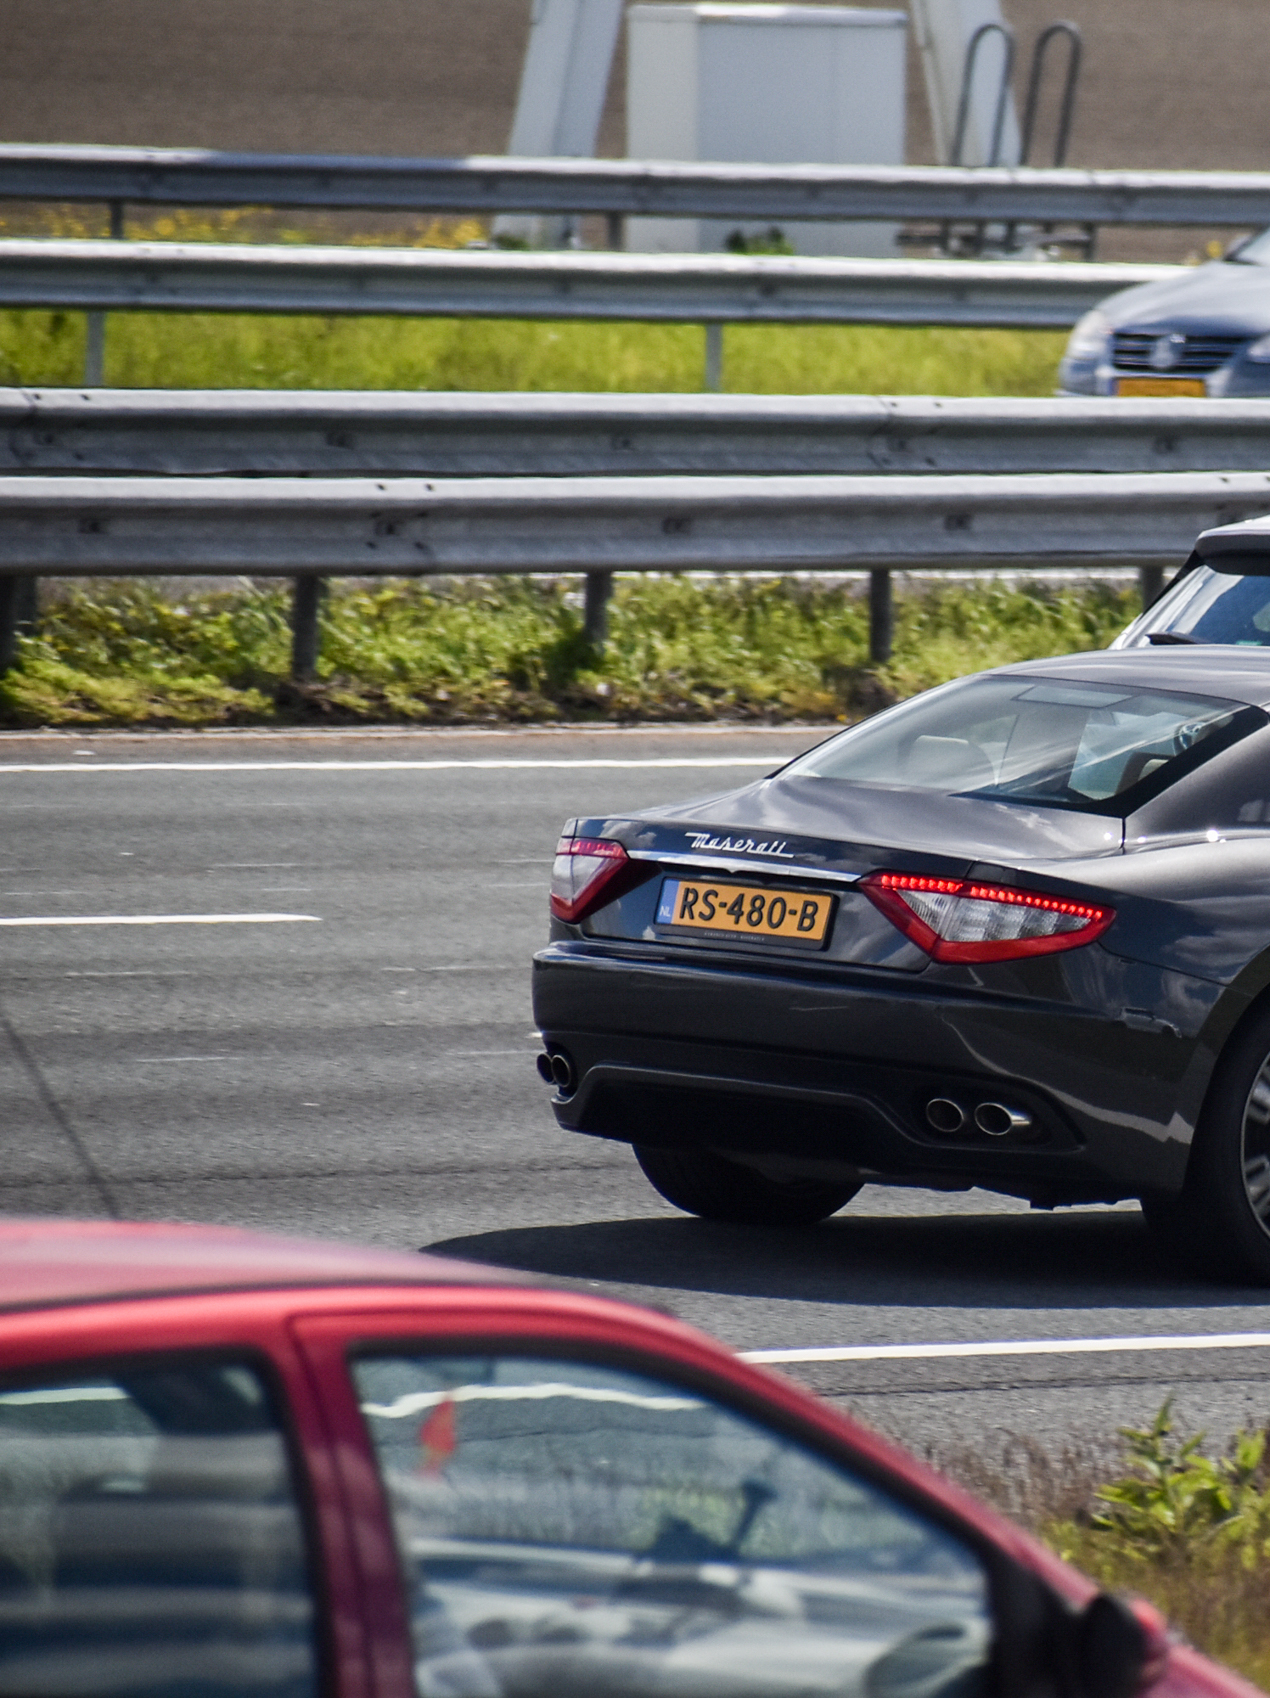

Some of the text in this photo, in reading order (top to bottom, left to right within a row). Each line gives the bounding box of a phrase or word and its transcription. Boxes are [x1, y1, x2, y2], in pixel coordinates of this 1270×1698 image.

[685, 832, 794, 858] Maserati
[659, 905, 671, 917] NL
[679, 887, 819, 932] RS-480-B
